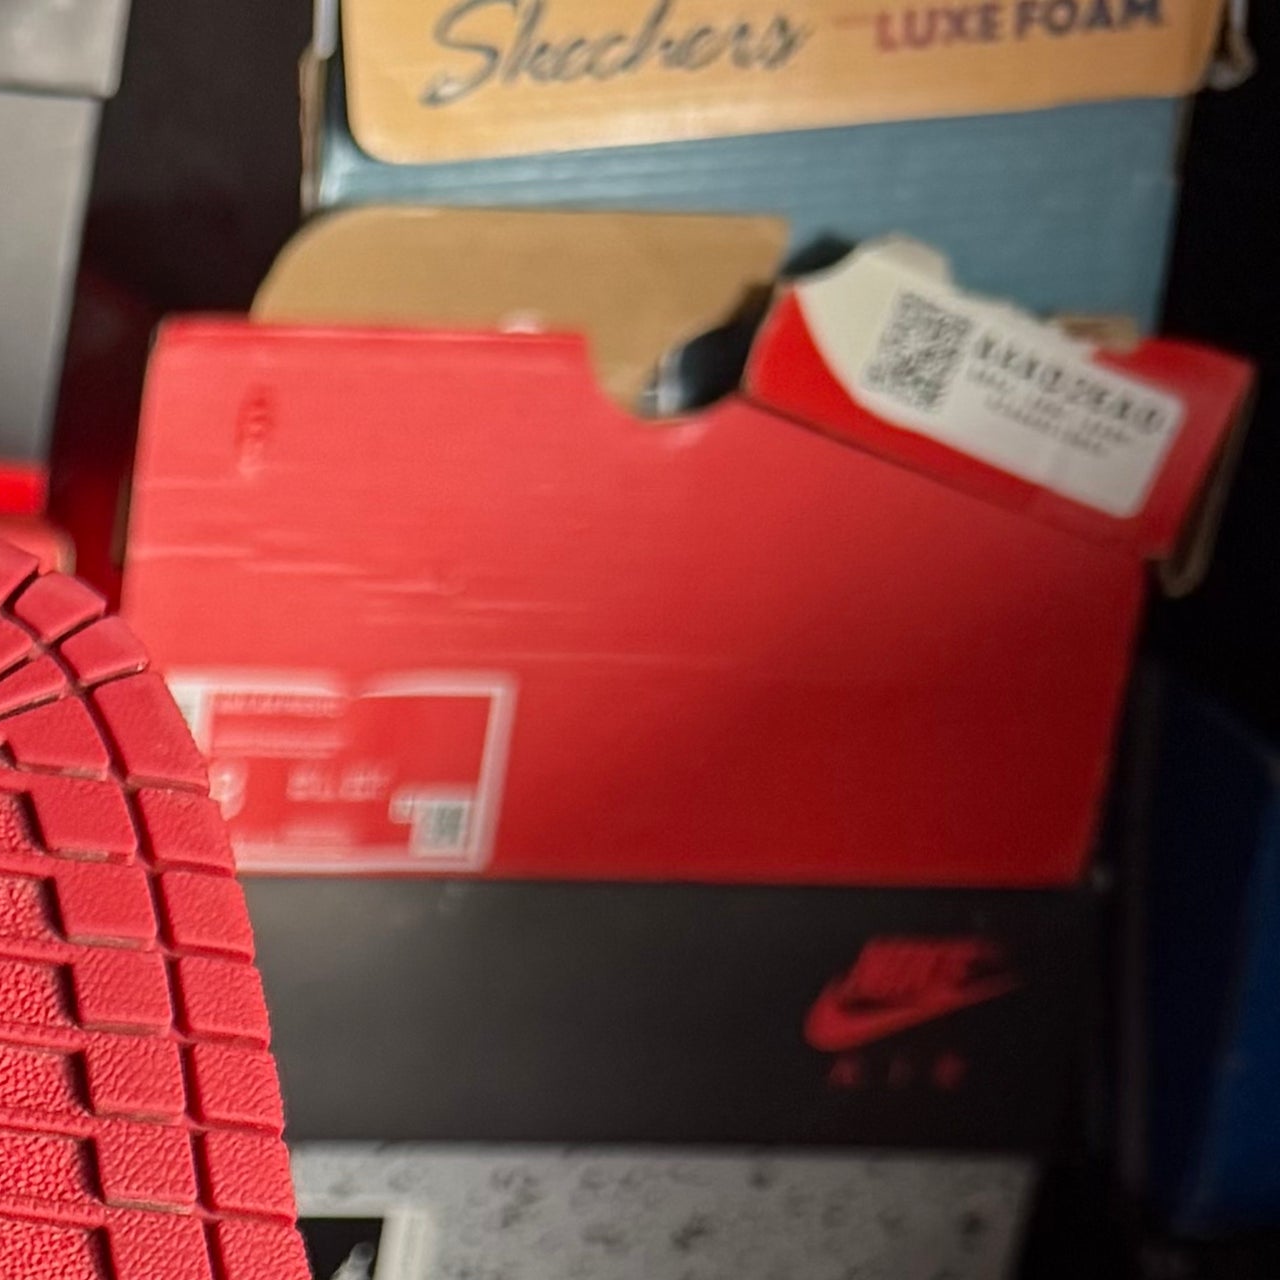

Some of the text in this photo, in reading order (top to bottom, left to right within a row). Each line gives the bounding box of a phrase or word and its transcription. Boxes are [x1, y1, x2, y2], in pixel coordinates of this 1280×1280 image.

[420, 0, 808, 107] Skechers
[874, 0, 1166, 53] LUXE FOAM
